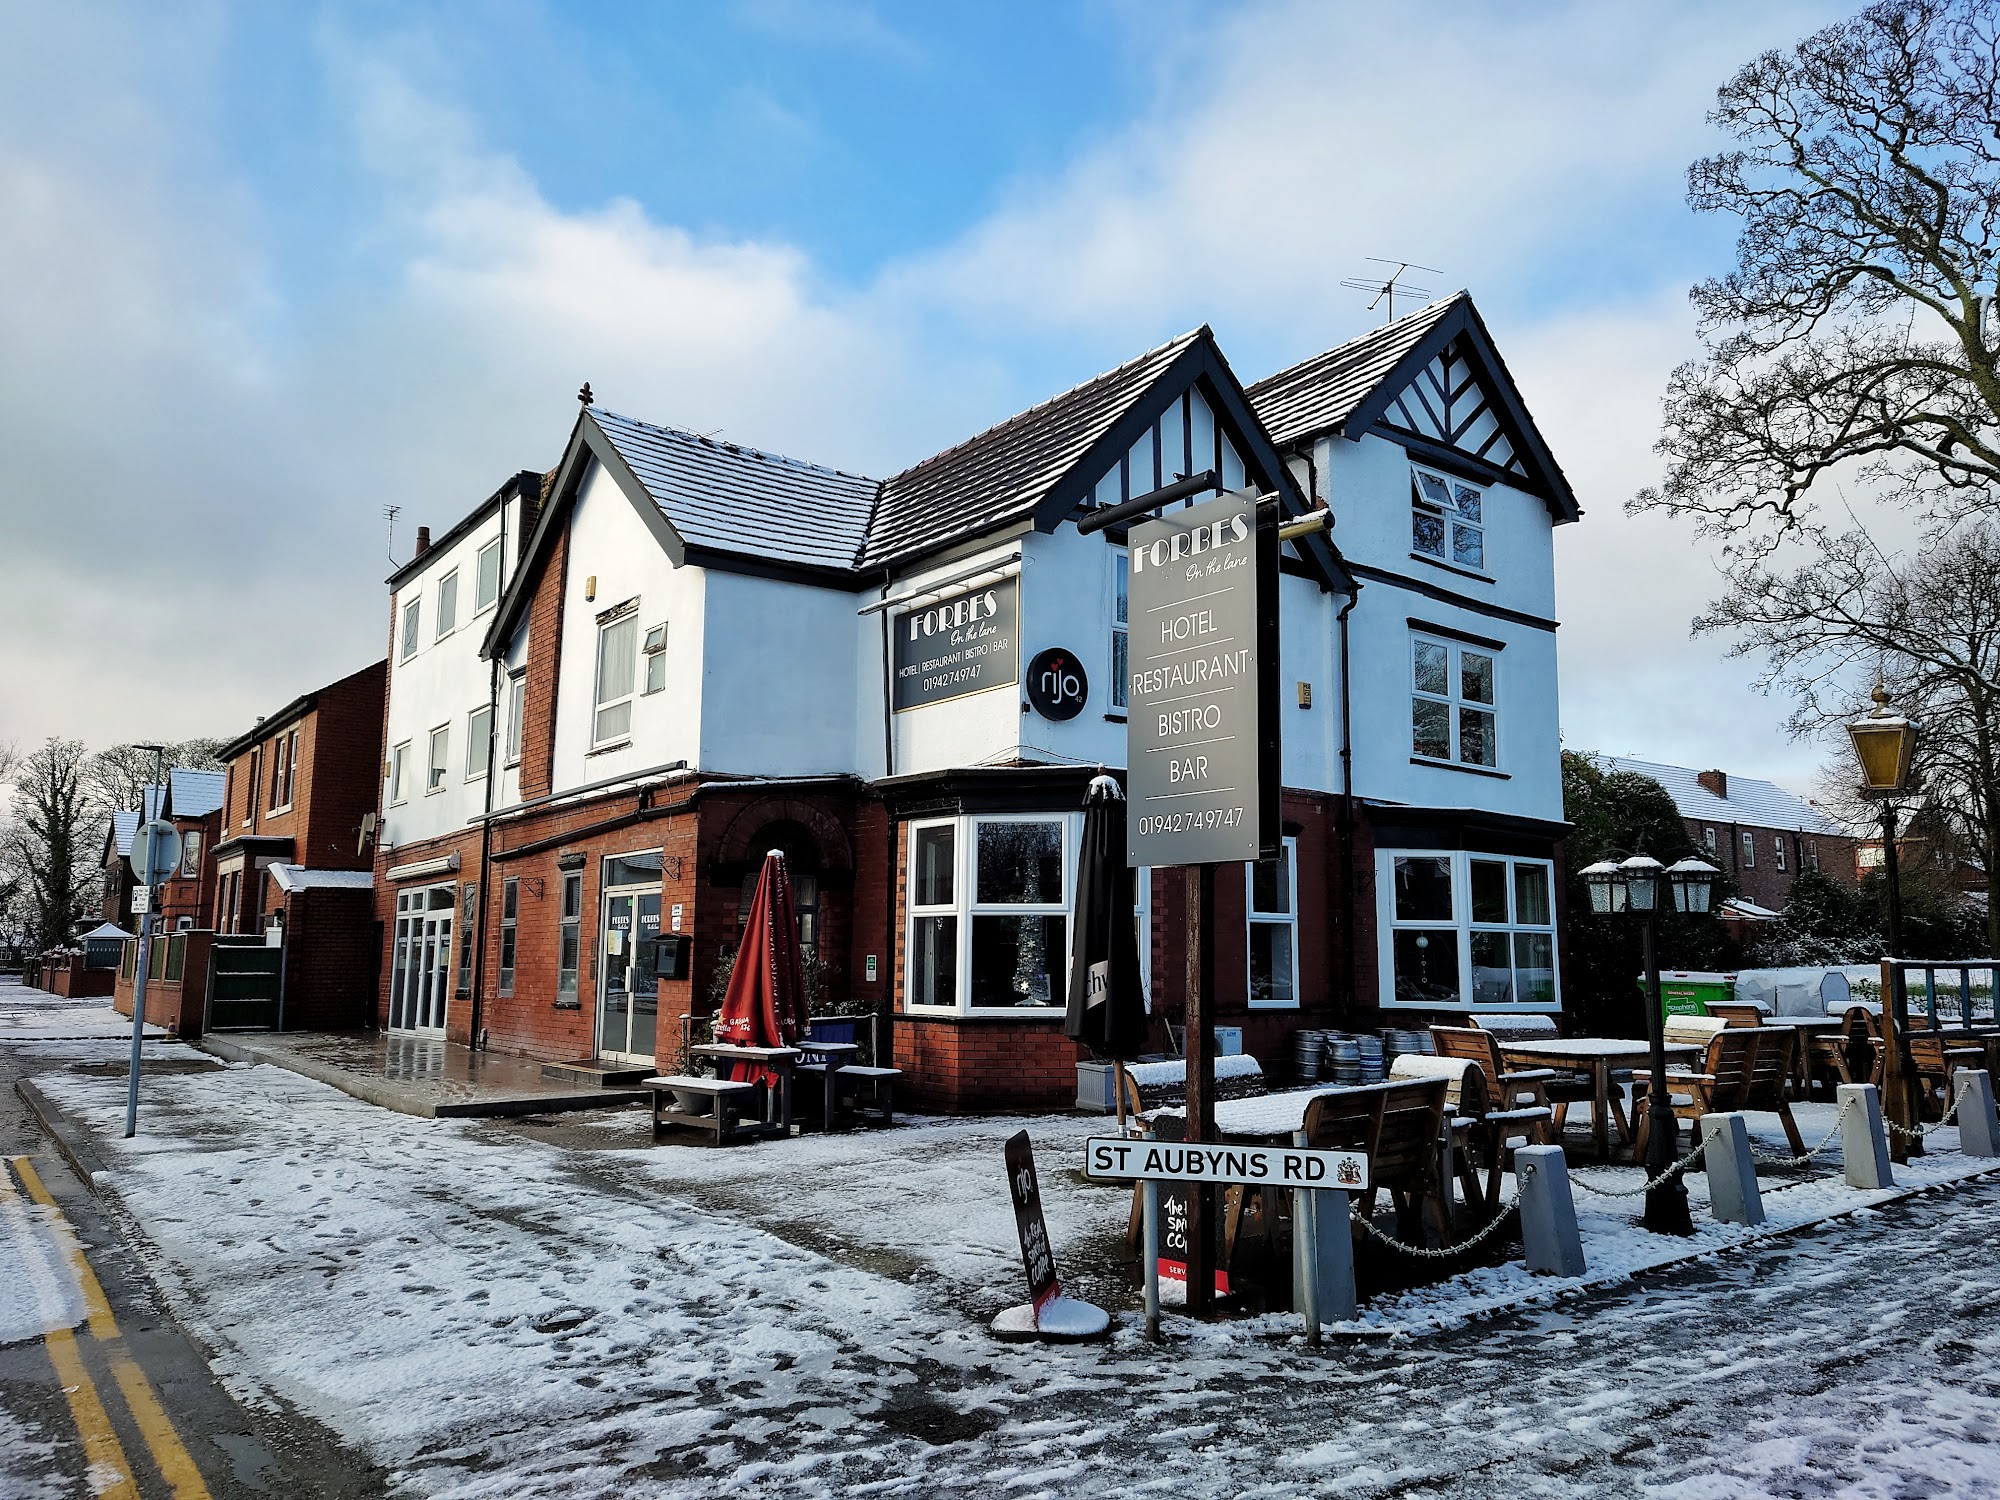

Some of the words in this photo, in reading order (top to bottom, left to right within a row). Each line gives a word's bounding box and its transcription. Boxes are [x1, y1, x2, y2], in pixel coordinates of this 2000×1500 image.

[1133, 513, 1248, 573] FORBES
[1185, 563, 1203, 582] On
[1205, 556, 1221, 577] the
[1223, 553, 1248, 571] lane
[910, 590, 997, 641] FORBES
[1160, 609, 1218, 643] HOTEL
[950, 630, 964, 646] On
[965, 628, 977, 643] the
[978, 621, 997, 638] lane
[899, 663, 918, 678] HOTEL
[921, 651, 961, 671] RESTAURANT
[965, 644, 988, 660] BISTRO
[993, 638, 1008, 652] BAR
[1132, 649, 1249, 696] RESTAURANT
[923, 671, 948, 692] 01942
[949, 664, 982, 686] 749747
[1041, 667, 1080, 704] rijo
[1158, 704, 1222, 737] BISTRO
[1169, 755, 1209, 784] BAR
[1138, 812, 1182, 836] 01942
[1184, 806, 1244, 832] 749747
[1093, 1146, 1131, 1171] ST
[1144, 1148, 1268, 1178] AUBYNS
[1283, 1155, 1326, 1181] RD
[1164, 1194, 1183, 1216] The
[1169, 1265, 1187, 1276] SERV
